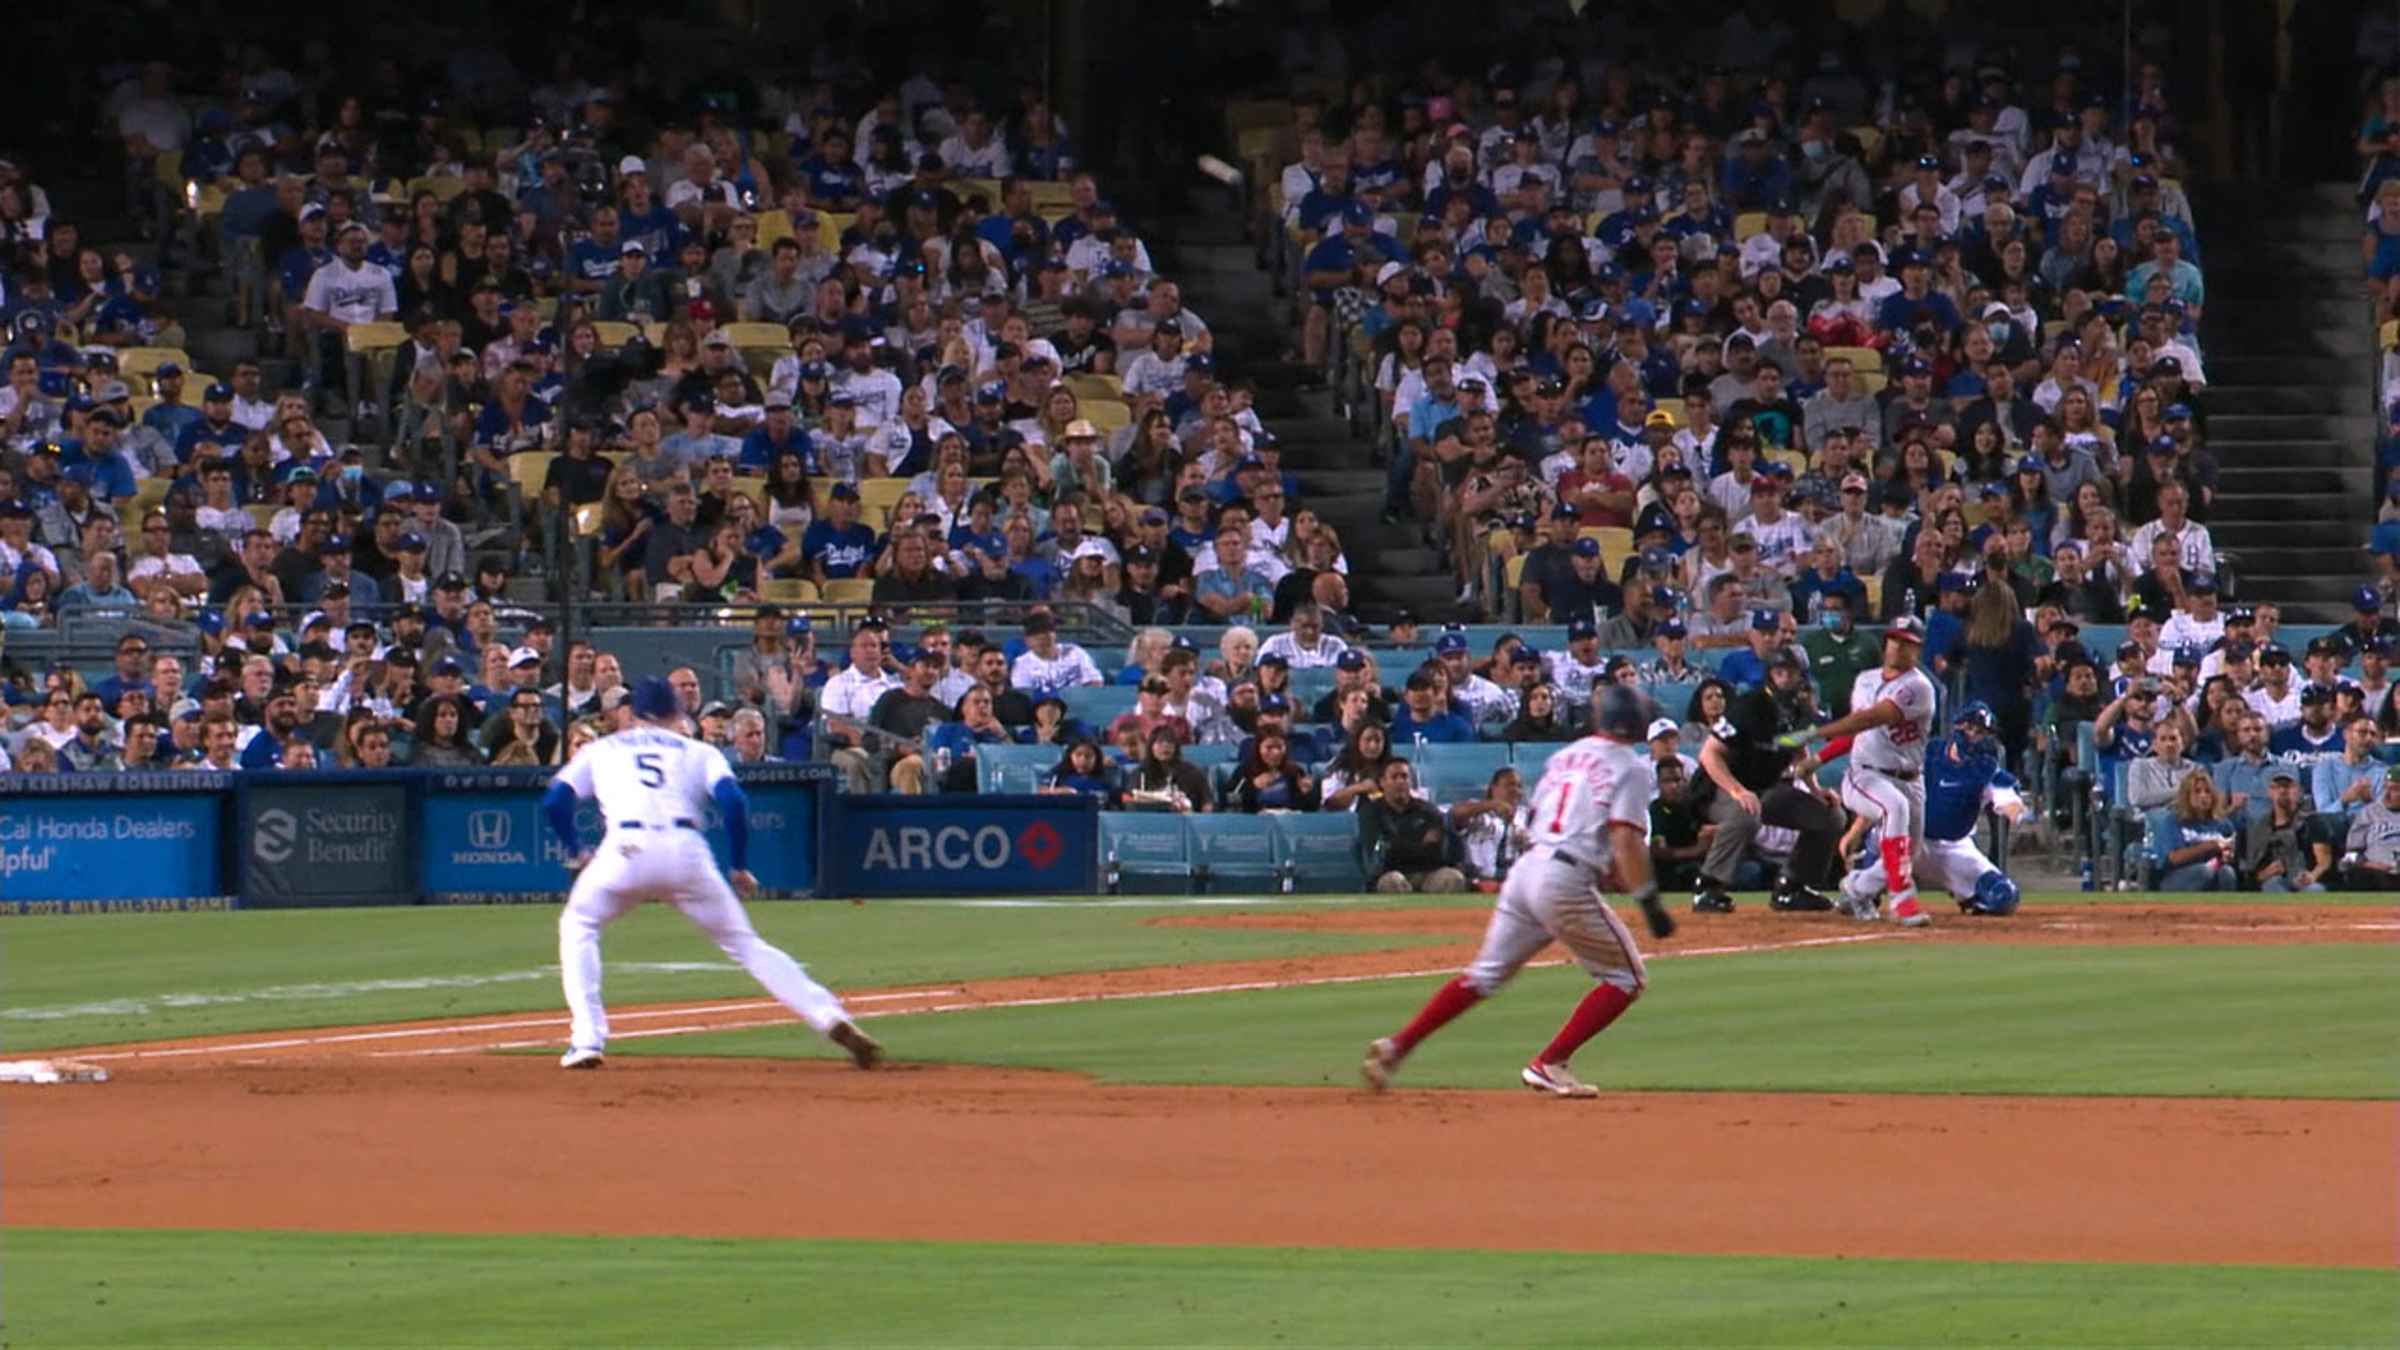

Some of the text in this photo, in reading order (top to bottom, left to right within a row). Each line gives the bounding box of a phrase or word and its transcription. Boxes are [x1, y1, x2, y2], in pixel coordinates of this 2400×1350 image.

[1889, 720, 1920, 746] 22
[635, 753, 666, 788] 5
[1549, 782, 1571, 833] 1
[38, 816, 109, 839] Honda
[115, 814, 195, 839] Dealers
[305, 808, 397, 838] Security
[308, 838, 386, 863] Benefit
[451, 852, 525, 864] HONDA
[863, 826, 1010, 870] ARCO
